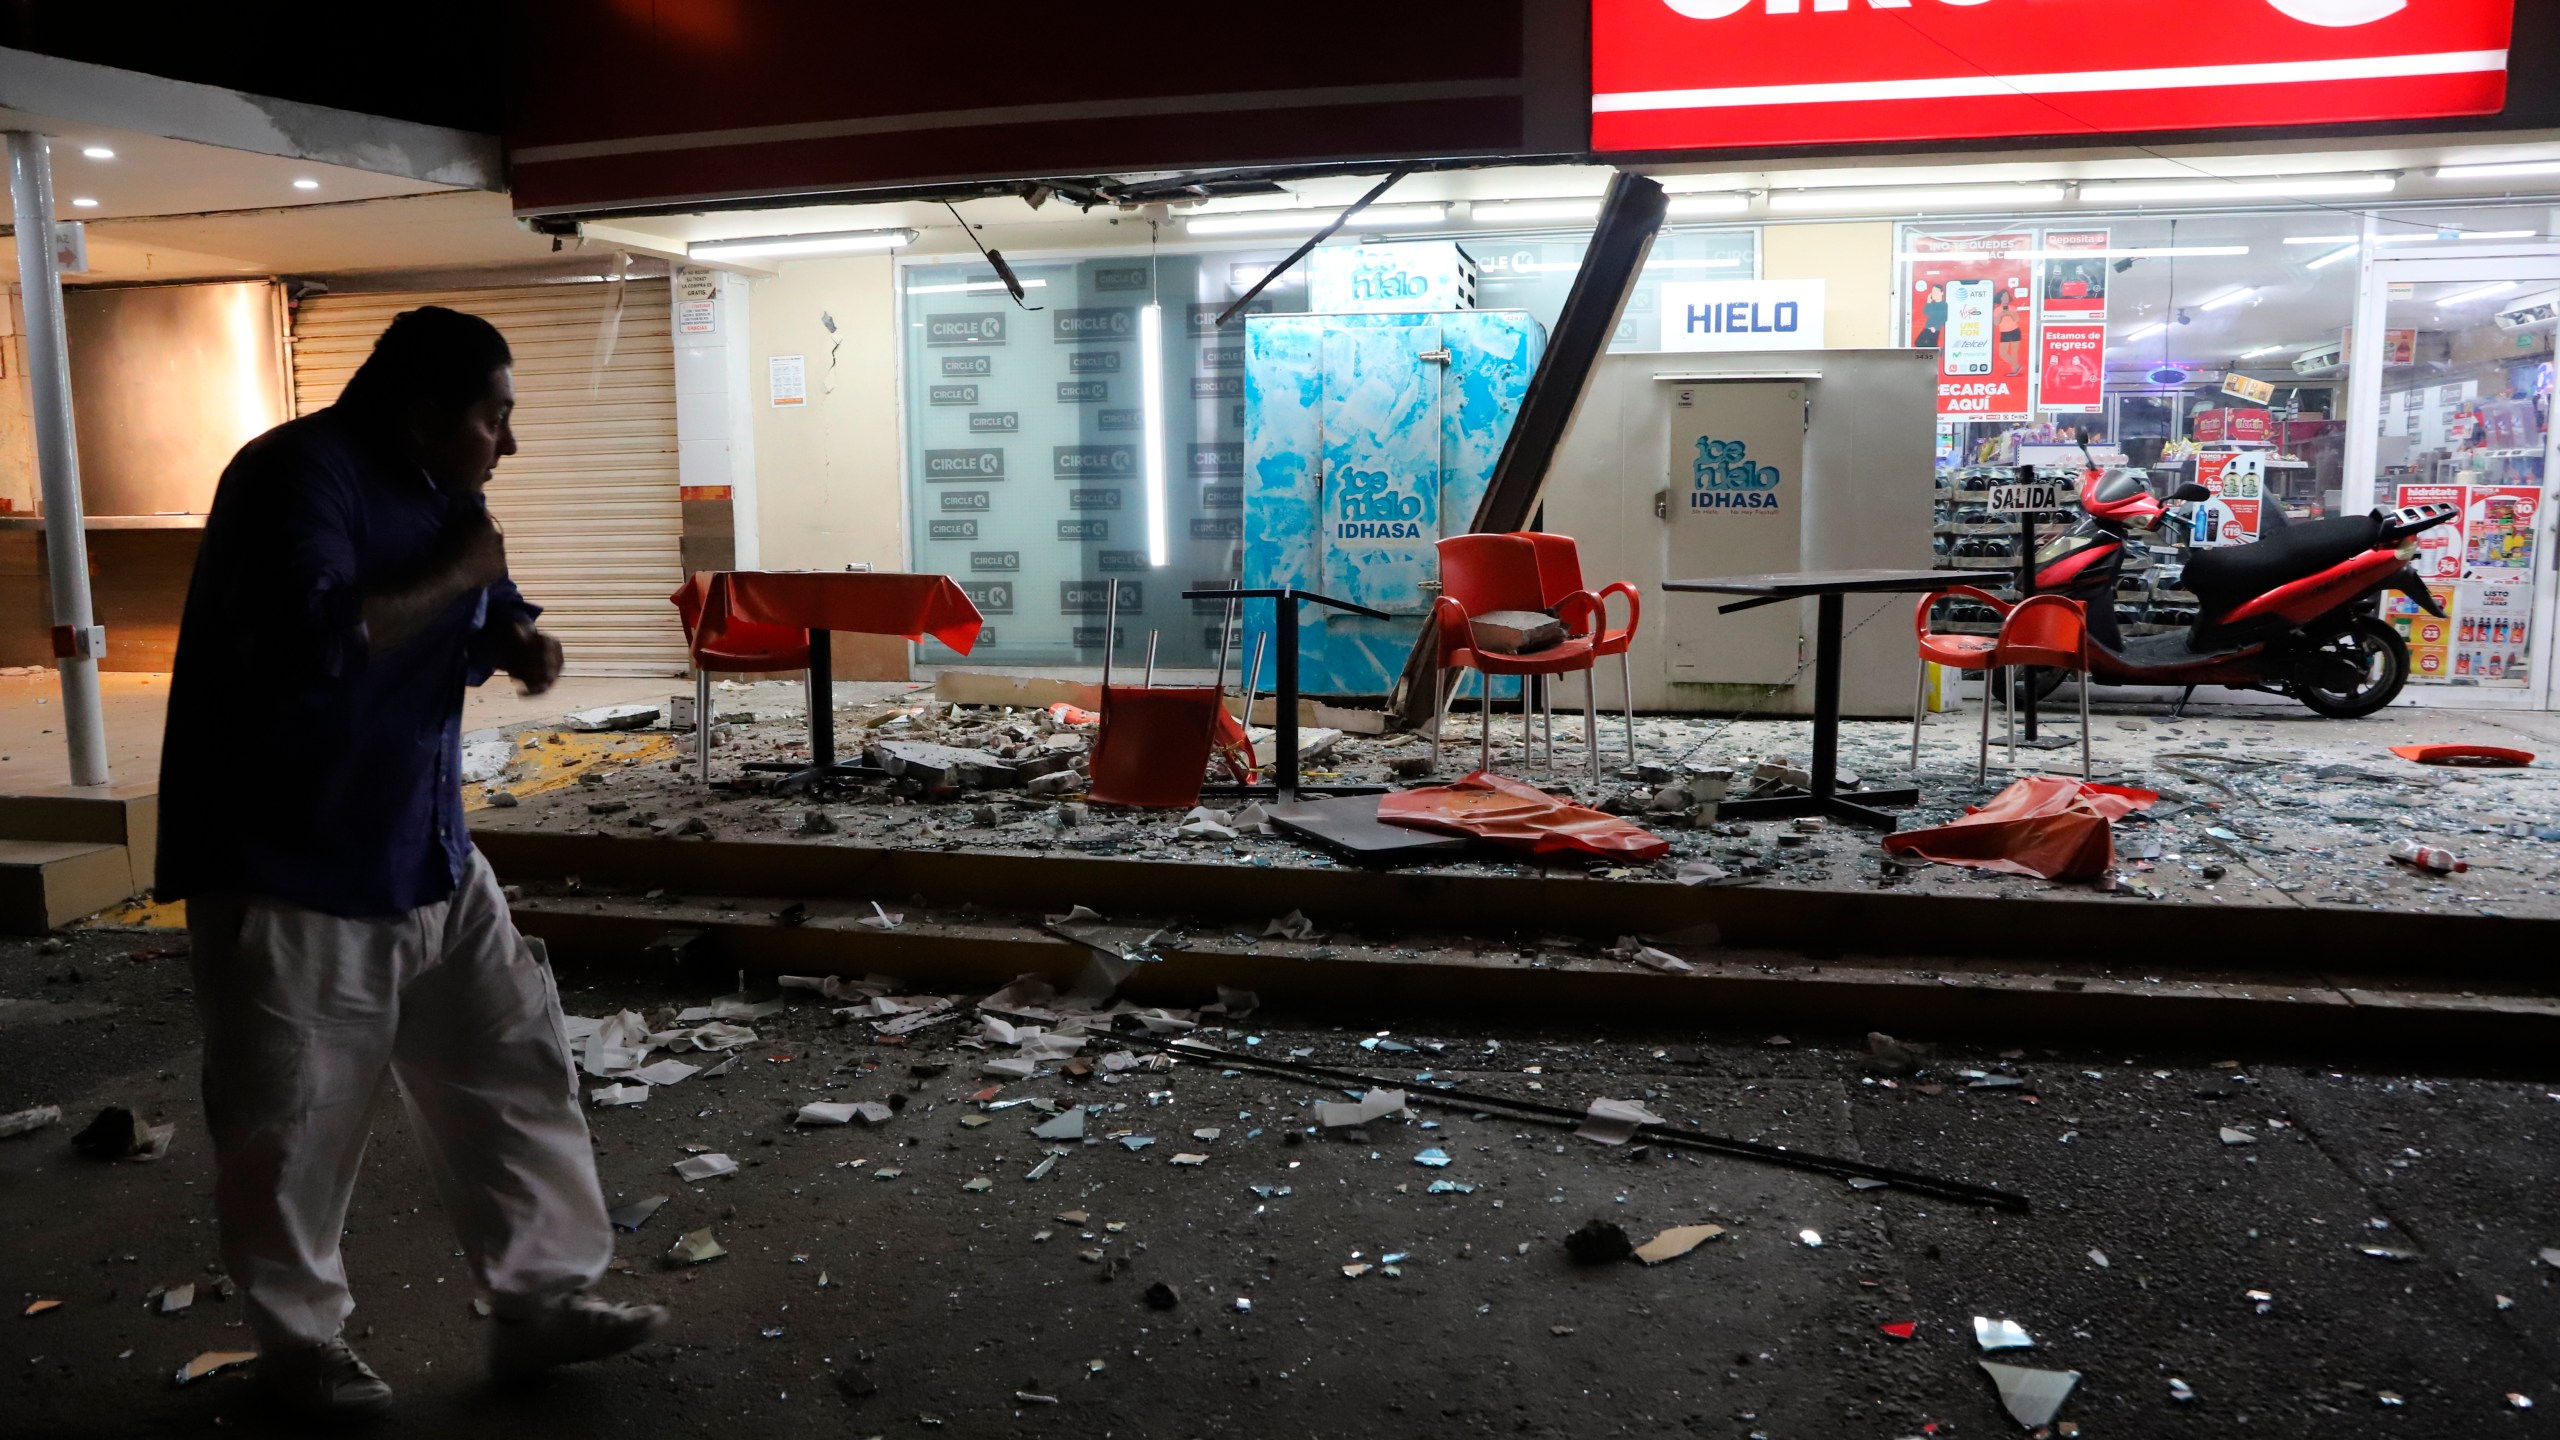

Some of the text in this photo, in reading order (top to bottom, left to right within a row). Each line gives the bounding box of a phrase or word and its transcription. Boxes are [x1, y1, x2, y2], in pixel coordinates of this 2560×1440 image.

[1969, 240, 2014, 249] QUEDES
[1060, 312, 1129, 332] CIRCLE K
[1687, 301, 1798, 333] HIELO
[933, 318, 999, 337] CIRCLE K
[2046, 332, 2085, 340] Estamos
[1961, 340, 1988, 348] telcel
[2050, 342, 2095, 350] regreso
[946, 359, 986, 372] CIRCLE K
[934, 388, 974, 400] CIRCLE K
[1061, 387, 1089, 395] CIRCLE
[1938, 382, 2010, 396] ECARGA
[1947, 396, 1991, 410] AQUÍ
[973, 415, 1015, 427] CIRCLE K
[1694, 435, 1746, 463] ice
[932, 454, 998, 473] CIRCLE K
[1060, 451, 1130, 470] CIRCLE K
[1340, 466, 1388, 494] ice
[1693, 460, 1780, 490] hielo
[974, 495, 986, 506] K
[1691, 493, 1778, 508] IDHASA
[1992, 487, 2056, 509] SALIDA
[1340, 490, 1421, 521] hielo
[963, 523, 974, 535] K
[1062, 526, 1090, 534] CIRCLE
[1338, 523, 1420, 538] IDHASA
[1004, 554, 1016, 567] K
[989, 587, 1006, 606] K
[1067, 591, 1109, 602] CIRCL
